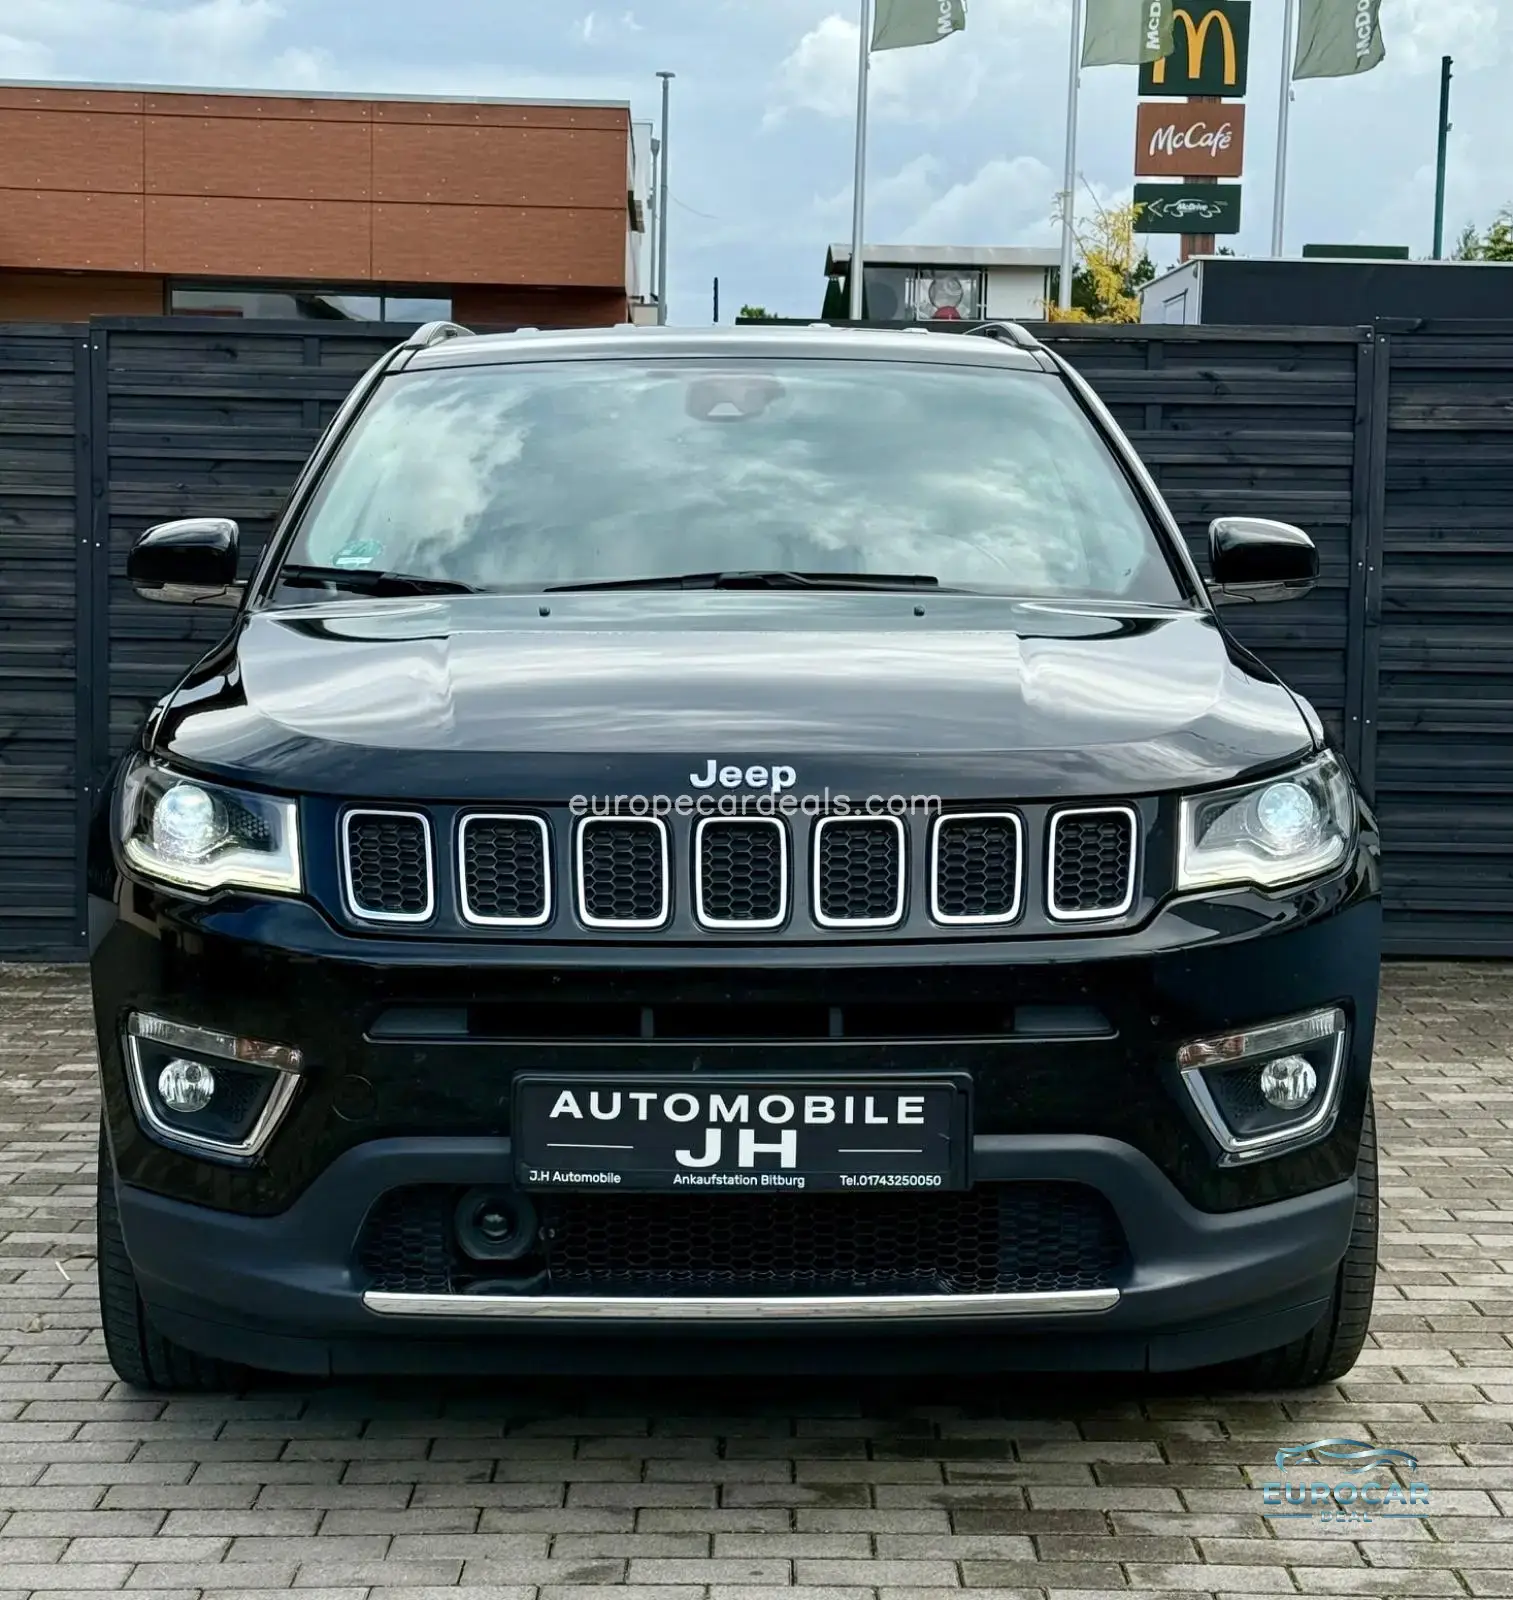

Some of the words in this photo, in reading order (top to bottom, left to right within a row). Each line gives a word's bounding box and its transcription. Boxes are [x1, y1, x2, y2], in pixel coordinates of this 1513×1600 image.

[937, 0, 953, 34] Mc
[1146, 0, 1162, 50] McD
[1149, 121, 1233, 157] McCafé
[689, 759, 797, 793] Jeep
[549, 1090, 925, 1125] AUTOMOBILE
[675, 1128, 797, 1168] JH
[529, 1170, 550, 1182] J.H
[552, 1171, 621, 1184] Automobile
[673, 1173, 758, 1186] Ankaufstation
[760, 1174, 805, 1189] Bitburg
[840, 1174, 942, 1187] Tel.01743250050
